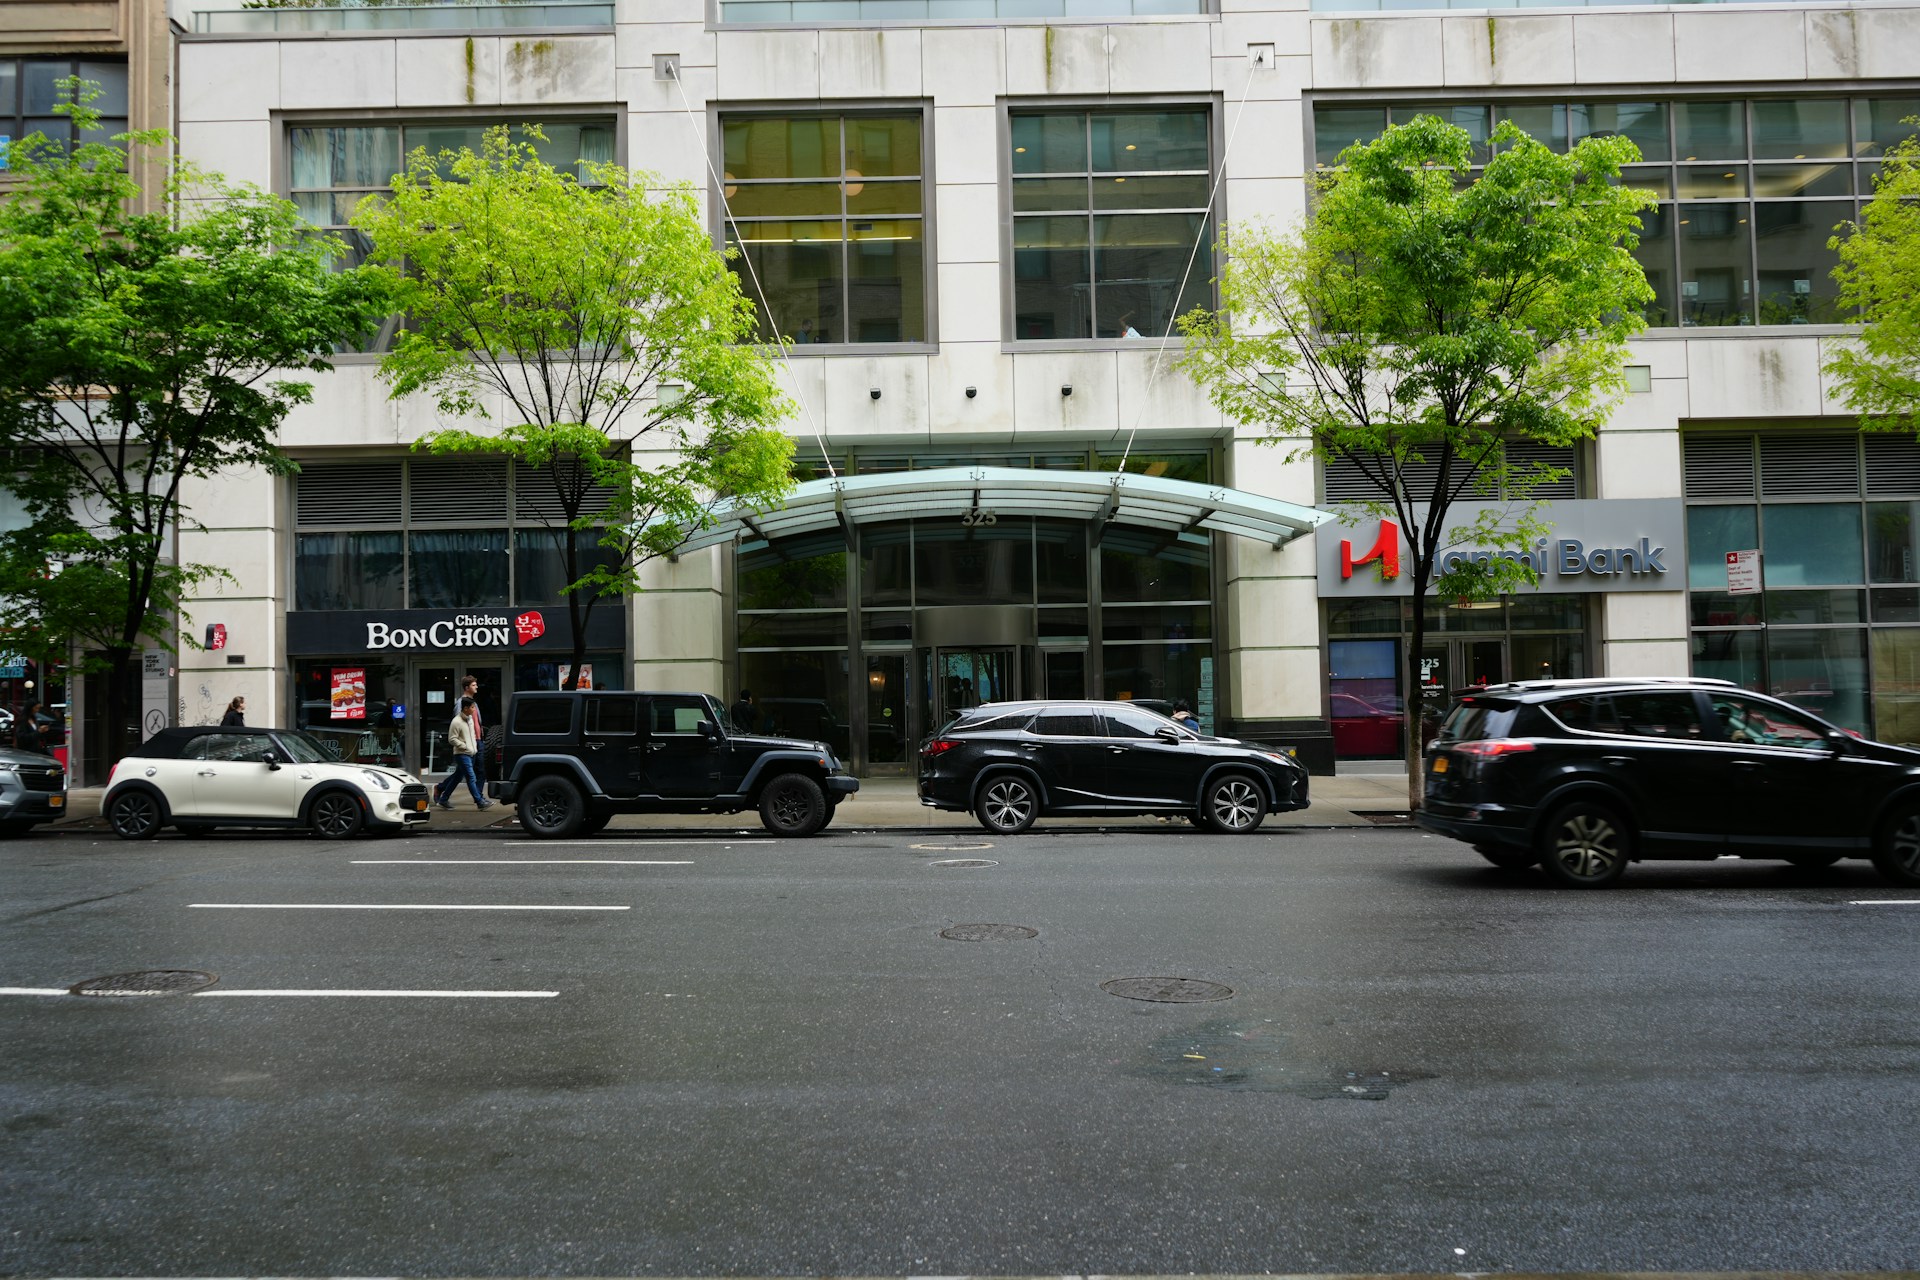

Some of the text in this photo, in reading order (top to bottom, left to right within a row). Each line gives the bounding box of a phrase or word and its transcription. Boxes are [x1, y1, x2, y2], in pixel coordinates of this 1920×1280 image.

[961, 511, 997, 526] 325
[1558, 536, 1668, 575] Bank
[455, 614, 508, 626] Chicken
[1420, 658, 1440, 668] 325
